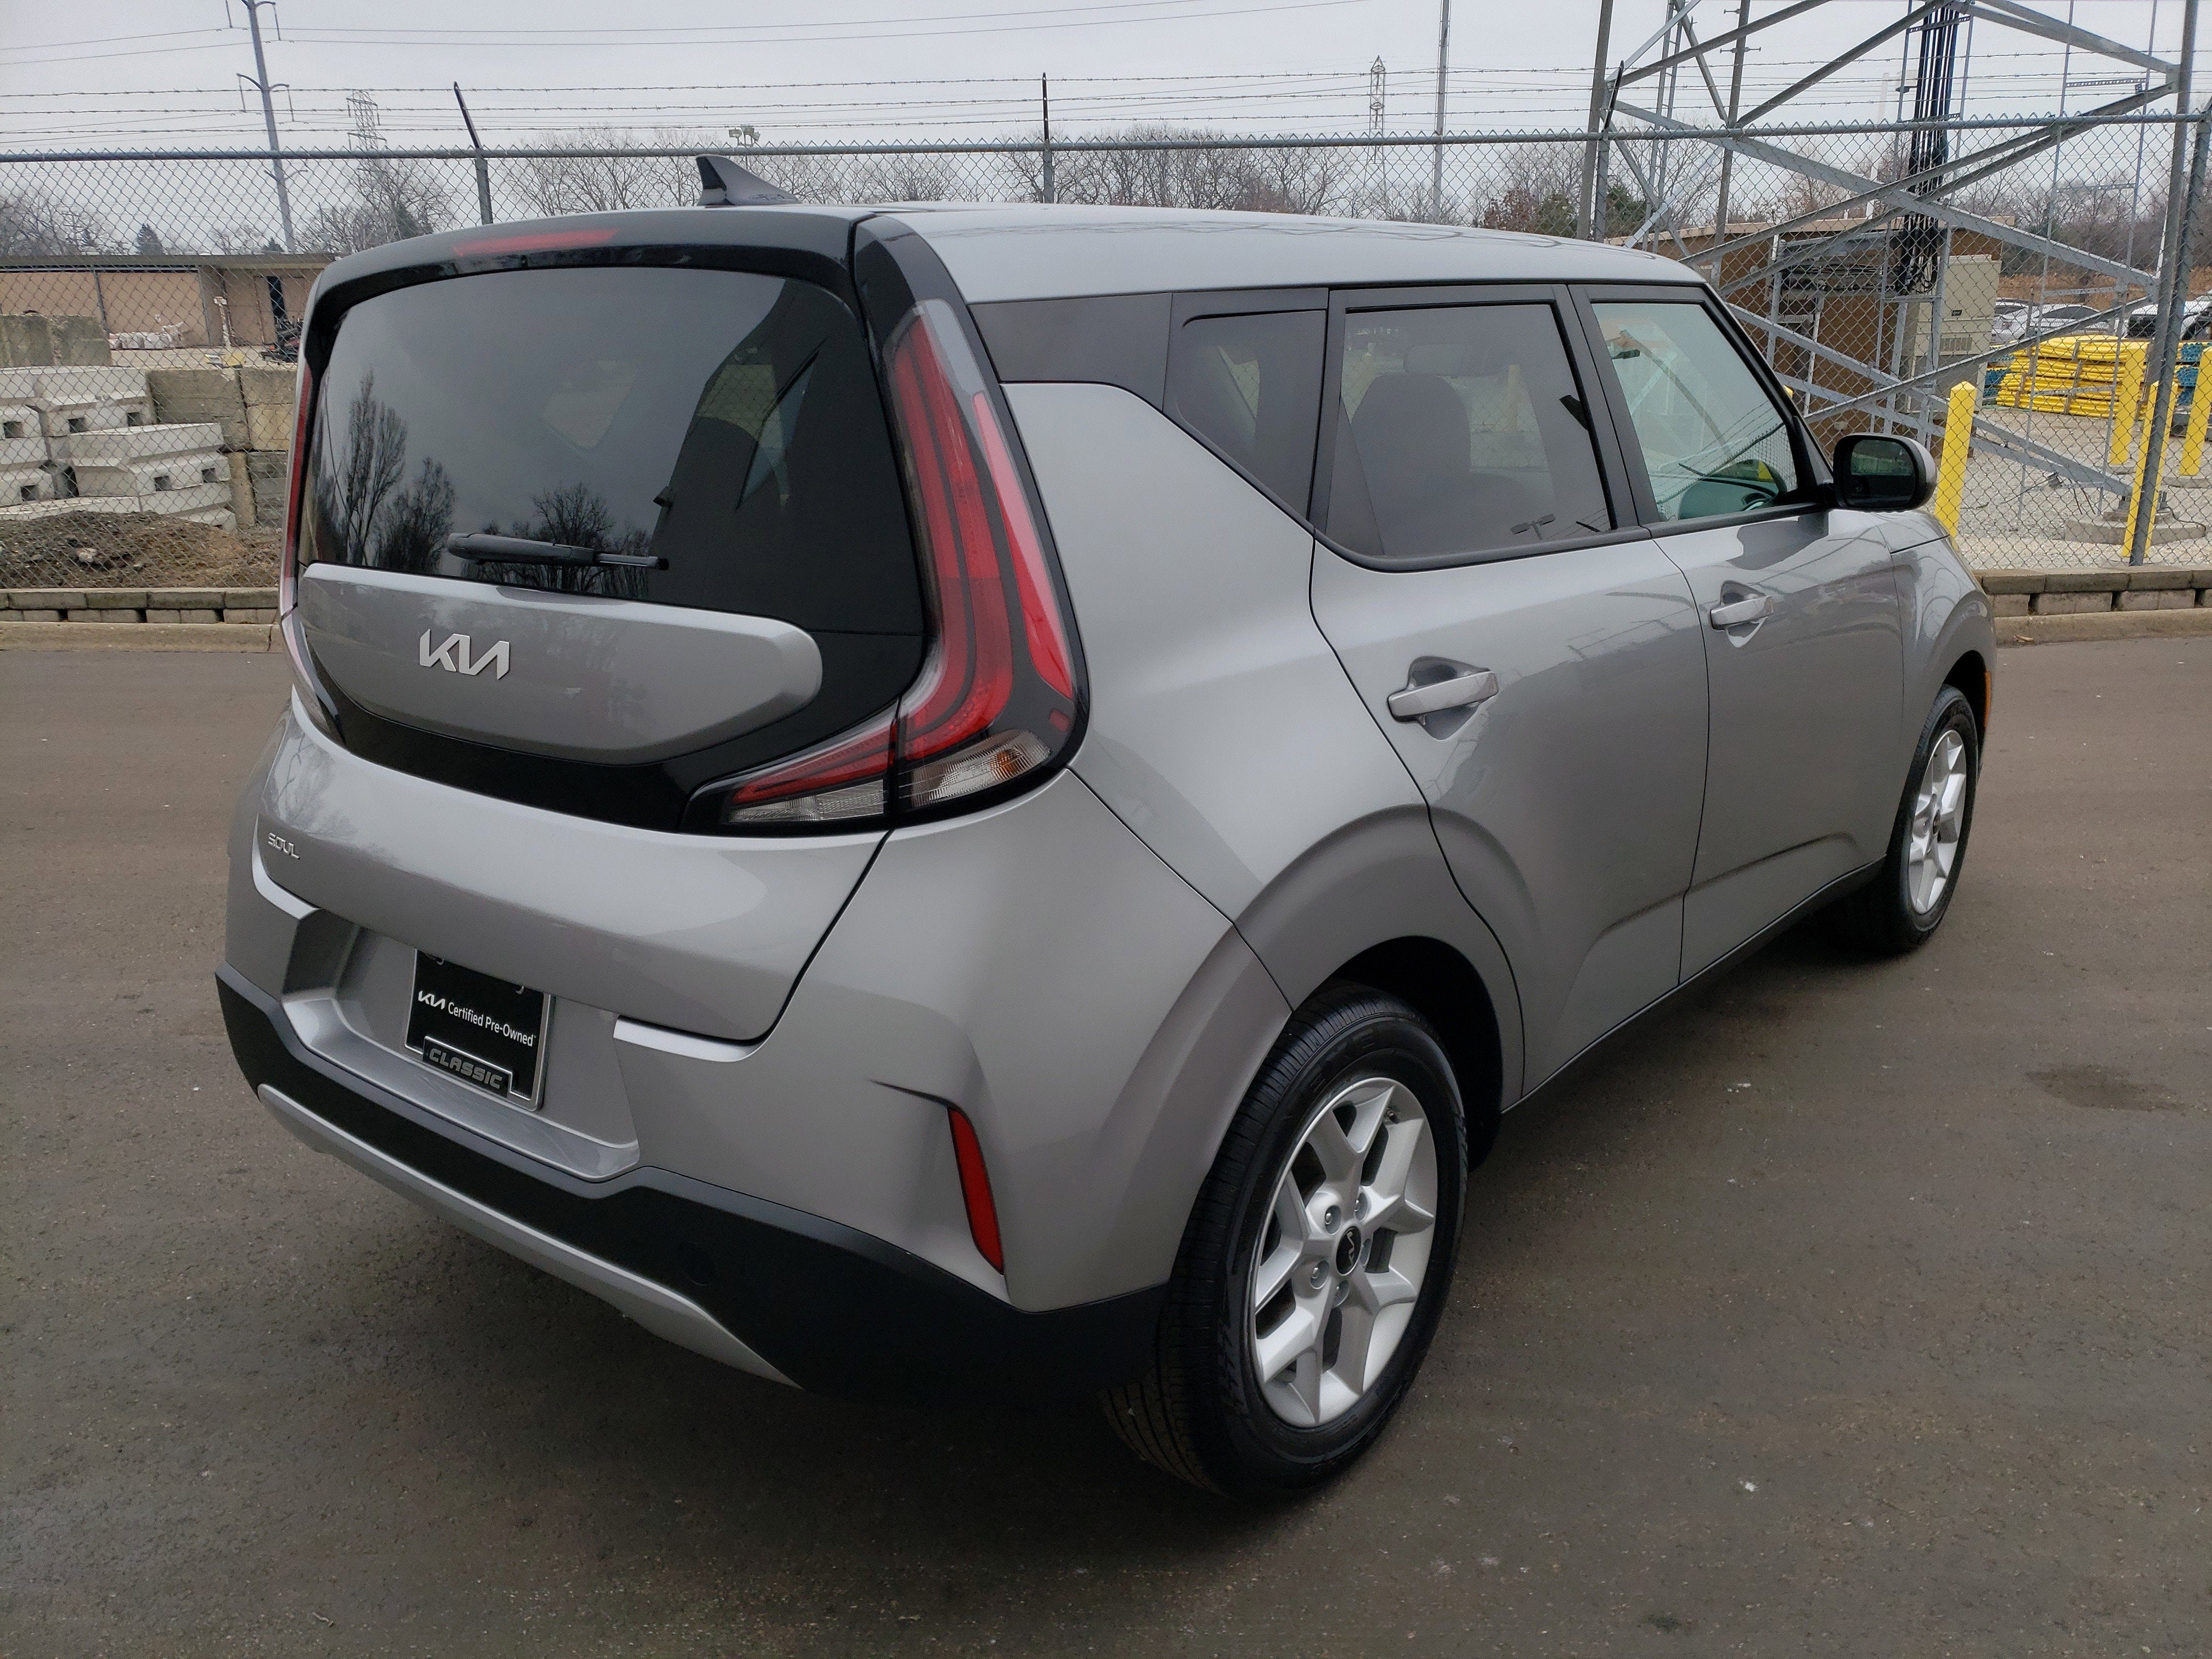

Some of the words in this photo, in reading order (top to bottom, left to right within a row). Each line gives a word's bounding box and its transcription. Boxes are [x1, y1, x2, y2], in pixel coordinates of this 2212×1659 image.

[420, 629, 510, 680] KIA
[268, 832, 300, 859] SOUL
[419, 990, 445, 1009] KIA
[448, 1002, 483, 1027] Certified
[486, 1017, 533, 1047] Pre-Owned
[430, 1048, 503, 1089] CLASSIC
